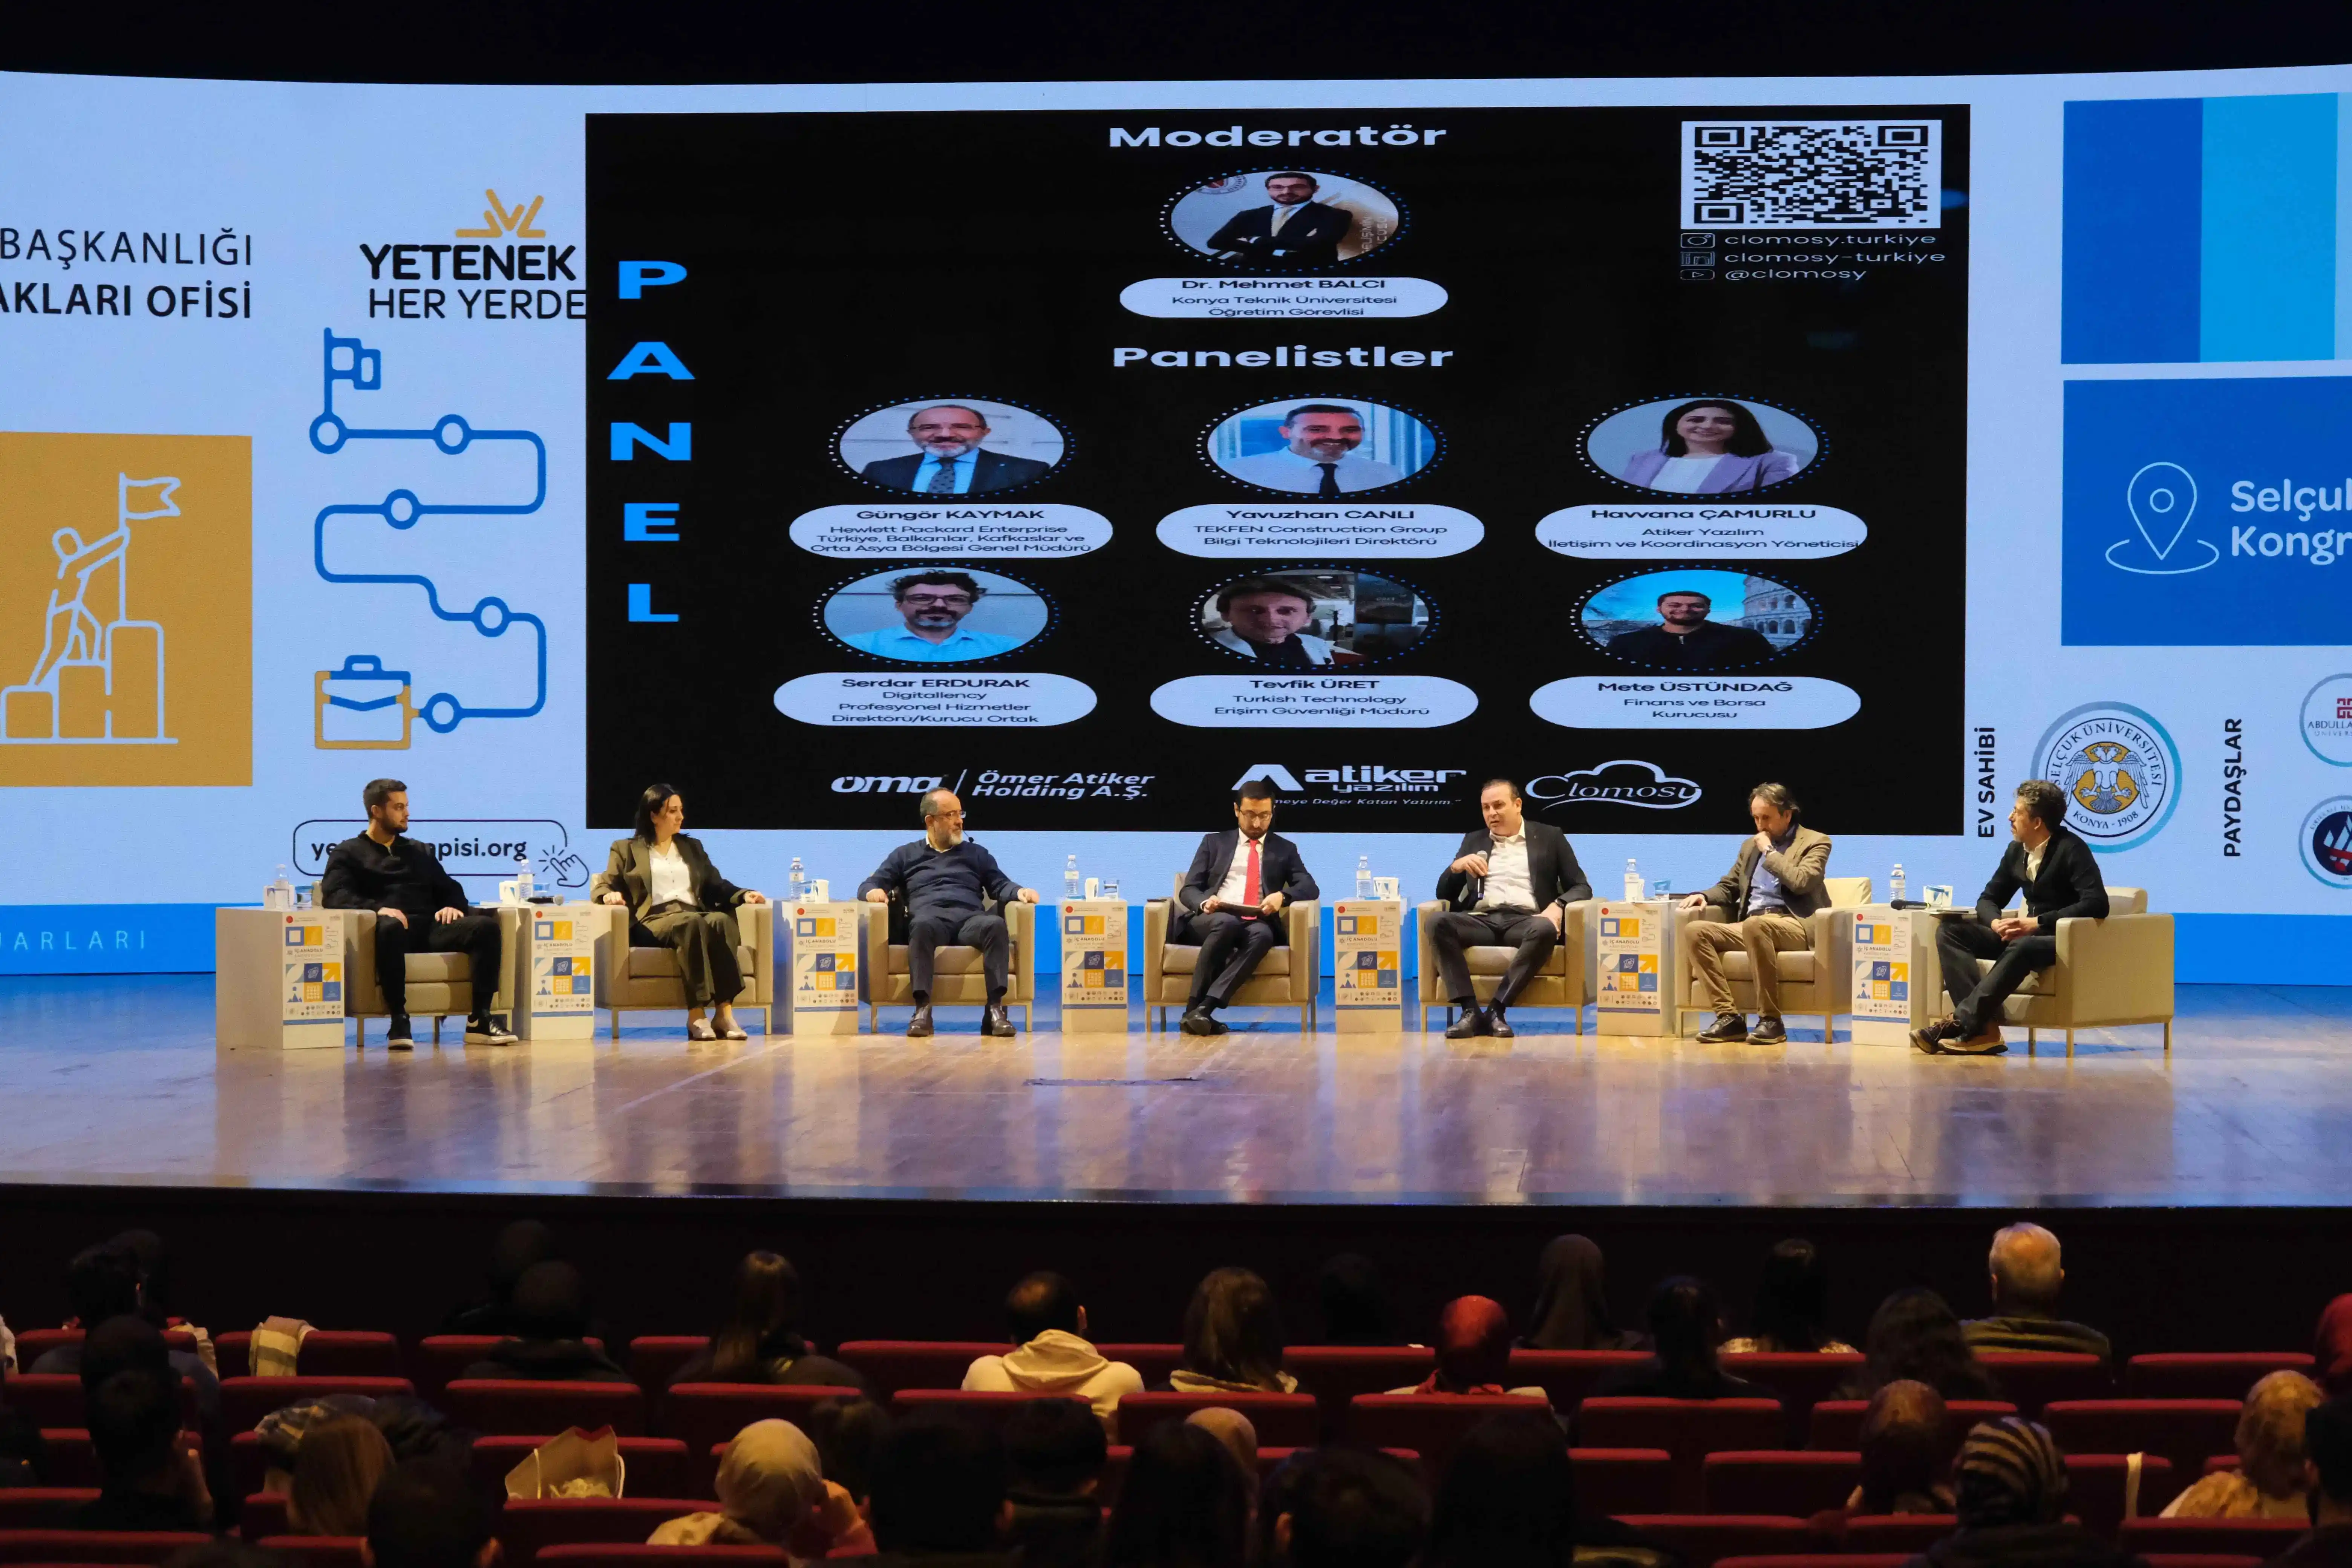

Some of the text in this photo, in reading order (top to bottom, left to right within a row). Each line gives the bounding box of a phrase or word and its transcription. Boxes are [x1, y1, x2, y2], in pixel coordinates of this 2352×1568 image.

[1110, 124, 1446, 147] Moderatör
[1725, 234, 1936, 247] clomosy.turkiye
[359, 243, 577, 281] YETENEK
[1724, 252, 1945, 265] clomosy-turkiye
[1725, 269, 1867, 280] @clomosy
[1219, 280, 1313, 289] Mehmet
[147, 280, 250, 318] OFİSİ
[369, 288, 586, 319] HER YERDE
[1208, 308, 1285, 317] Öğretim
[1113, 345, 1453, 367] Panelistler
[607, 261, 696, 622] PANEL
[856, 510, 1044, 521] Güngör KAYMAK
[1226, 510, 1414, 519] Yavuzhan CANLI
[1592, 510, 1816, 520] Havvana ÇAMURLU
[1391, 526, 1447, 534] Group
[817, 535, 881, 544] Türkiye,
[1204, 537, 1240, 546] Bilgi
[1245, 537, 1350, 546] Teknolojileri
[1549, 539, 1611, 548] İletişim
[1641, 540, 1767, 549] Koordinasyon
[902, 544, 963, 553] Bölgesi
[842, 679, 1030, 688] Serdar ERDURAK
[1250, 679, 1380, 689] Tevfik ÜRET
[1598, 681, 1793, 692] Mete ÜSTÜNDAĞ
[883, 692, 987, 700] Digitallency
[1301, 696, 1407, 704] Technology
[839, 703, 941, 712] Profesyonel
[1215, 707, 1268, 715] Erişim
[1272, 707, 1355, 716] Güvenliği
[978, 770, 1155, 784] Ömer Atiker
[1305, 766, 1467, 782] atiker
[1332, 783, 1438, 793] yazılım
[1525, 776, 1702, 799] Clomosy
[1974, 727, 1995, 838] EV SAHİBİ
[2224, 718, 2247, 857] PAYDAŞLAR
[972, 785, 1147, 800] Holding A.Ş.
[2073, 811, 2109, 829] KONYA
[2118, 811, 2139, 827] 1908
[0, 930, 145, 951] ARLARI
